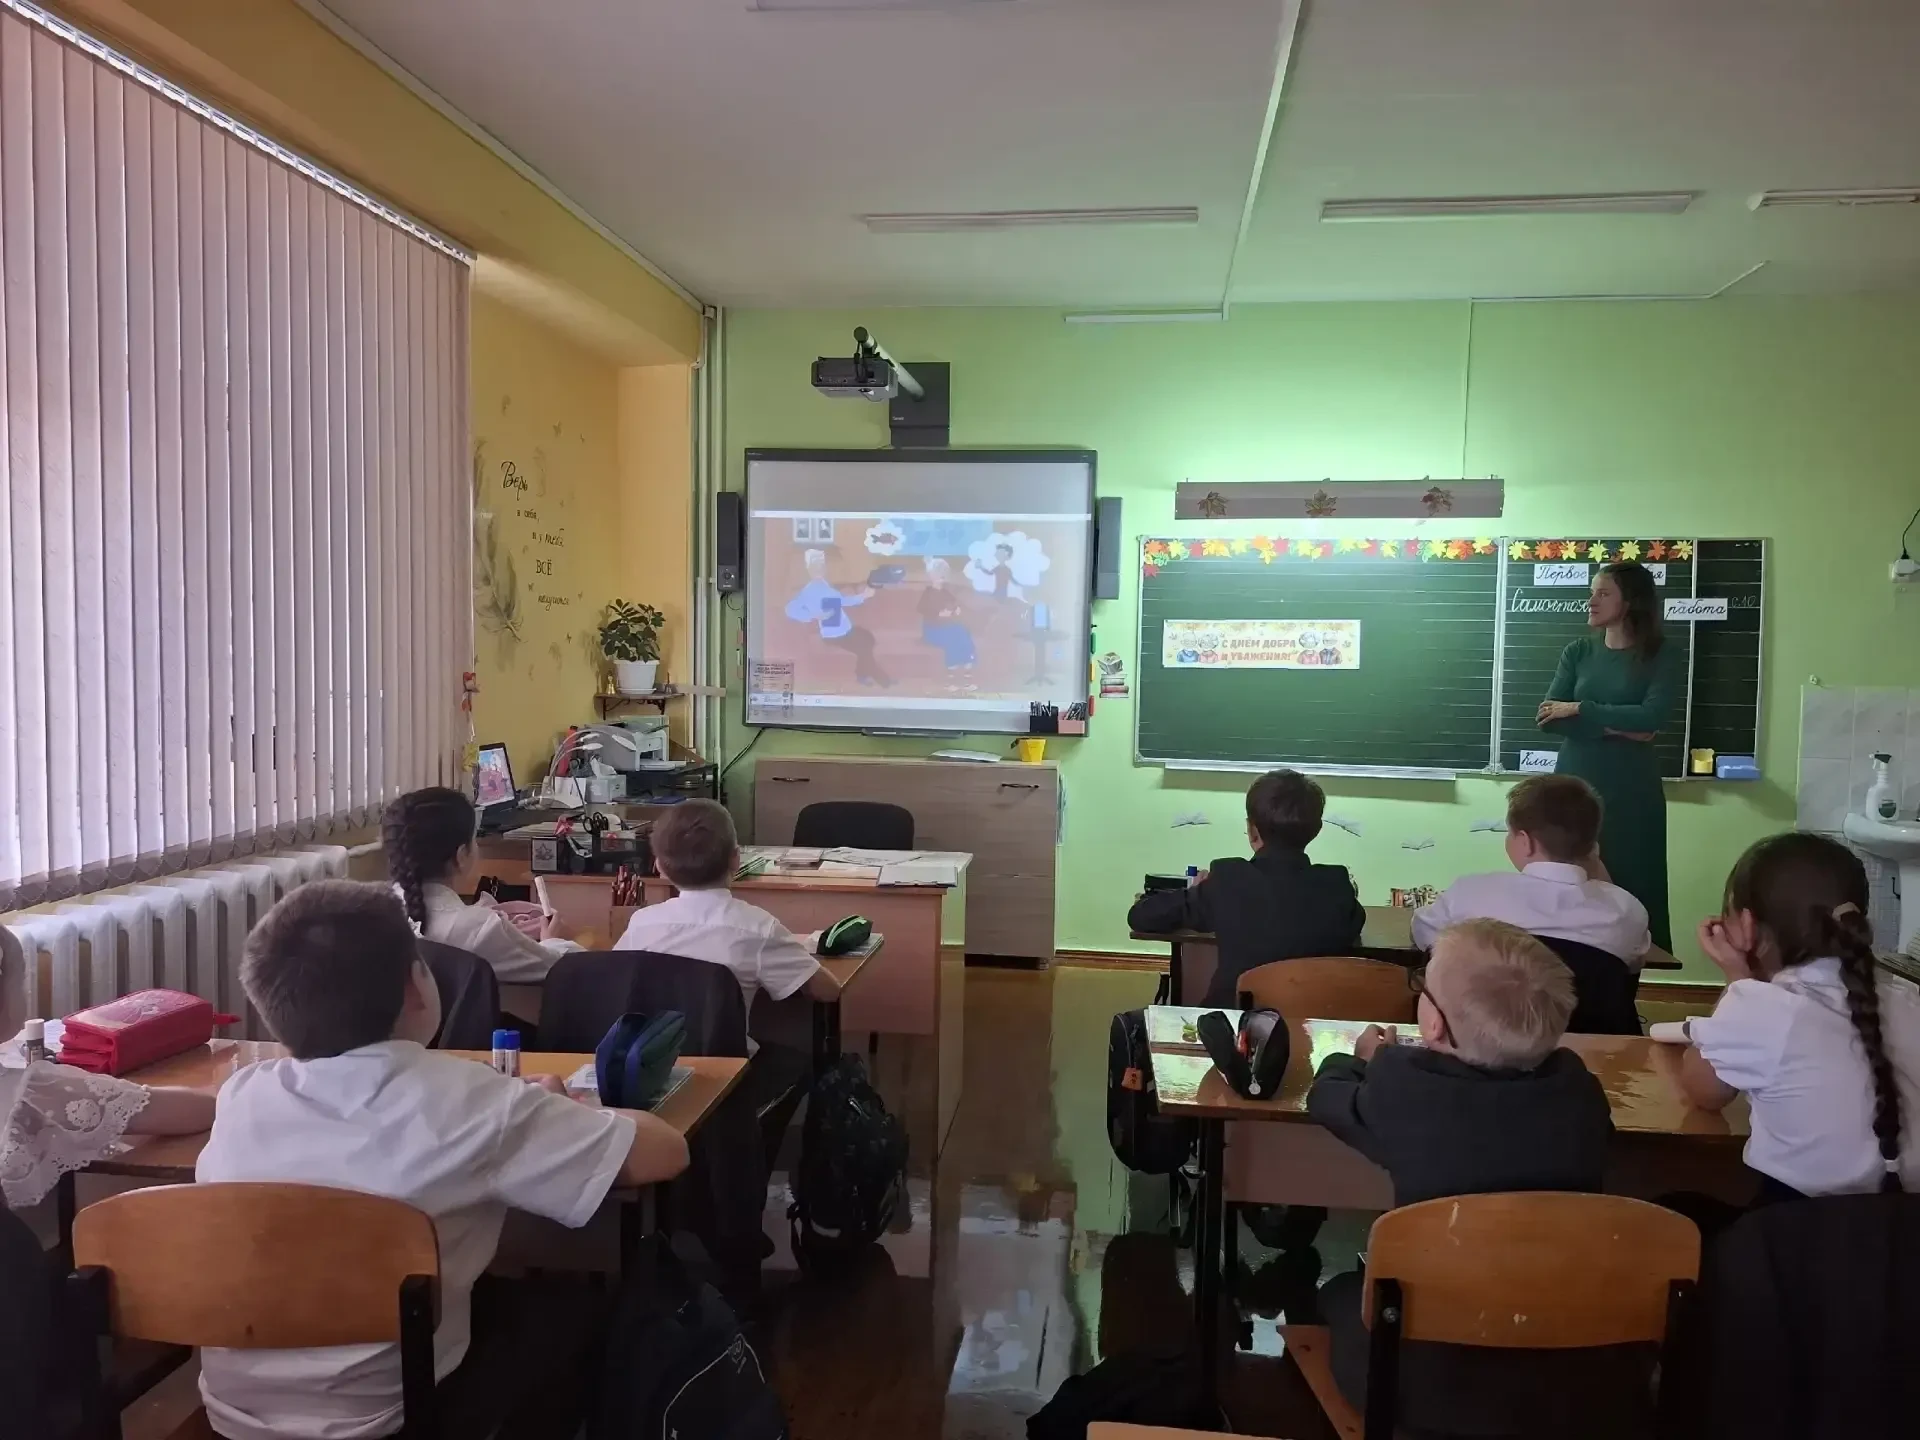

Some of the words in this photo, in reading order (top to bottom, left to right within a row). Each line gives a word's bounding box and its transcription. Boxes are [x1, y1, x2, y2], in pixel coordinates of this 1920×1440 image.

[500, 460, 528, 502] Верь
[535, 558, 553, 576] ВСЁ
[1536, 564, 1588, 586] Первое
[1511, 587, 1592, 613] Самостоя
[1664, 599, 1727, 620] работа
[1221, 639, 1229, 648] С
[1262, 639, 1296, 649] ДОБРА
[1231, 652, 1291, 661] УВАЖЕНИЯ!
[1520, 751, 1556, 766] Клас
